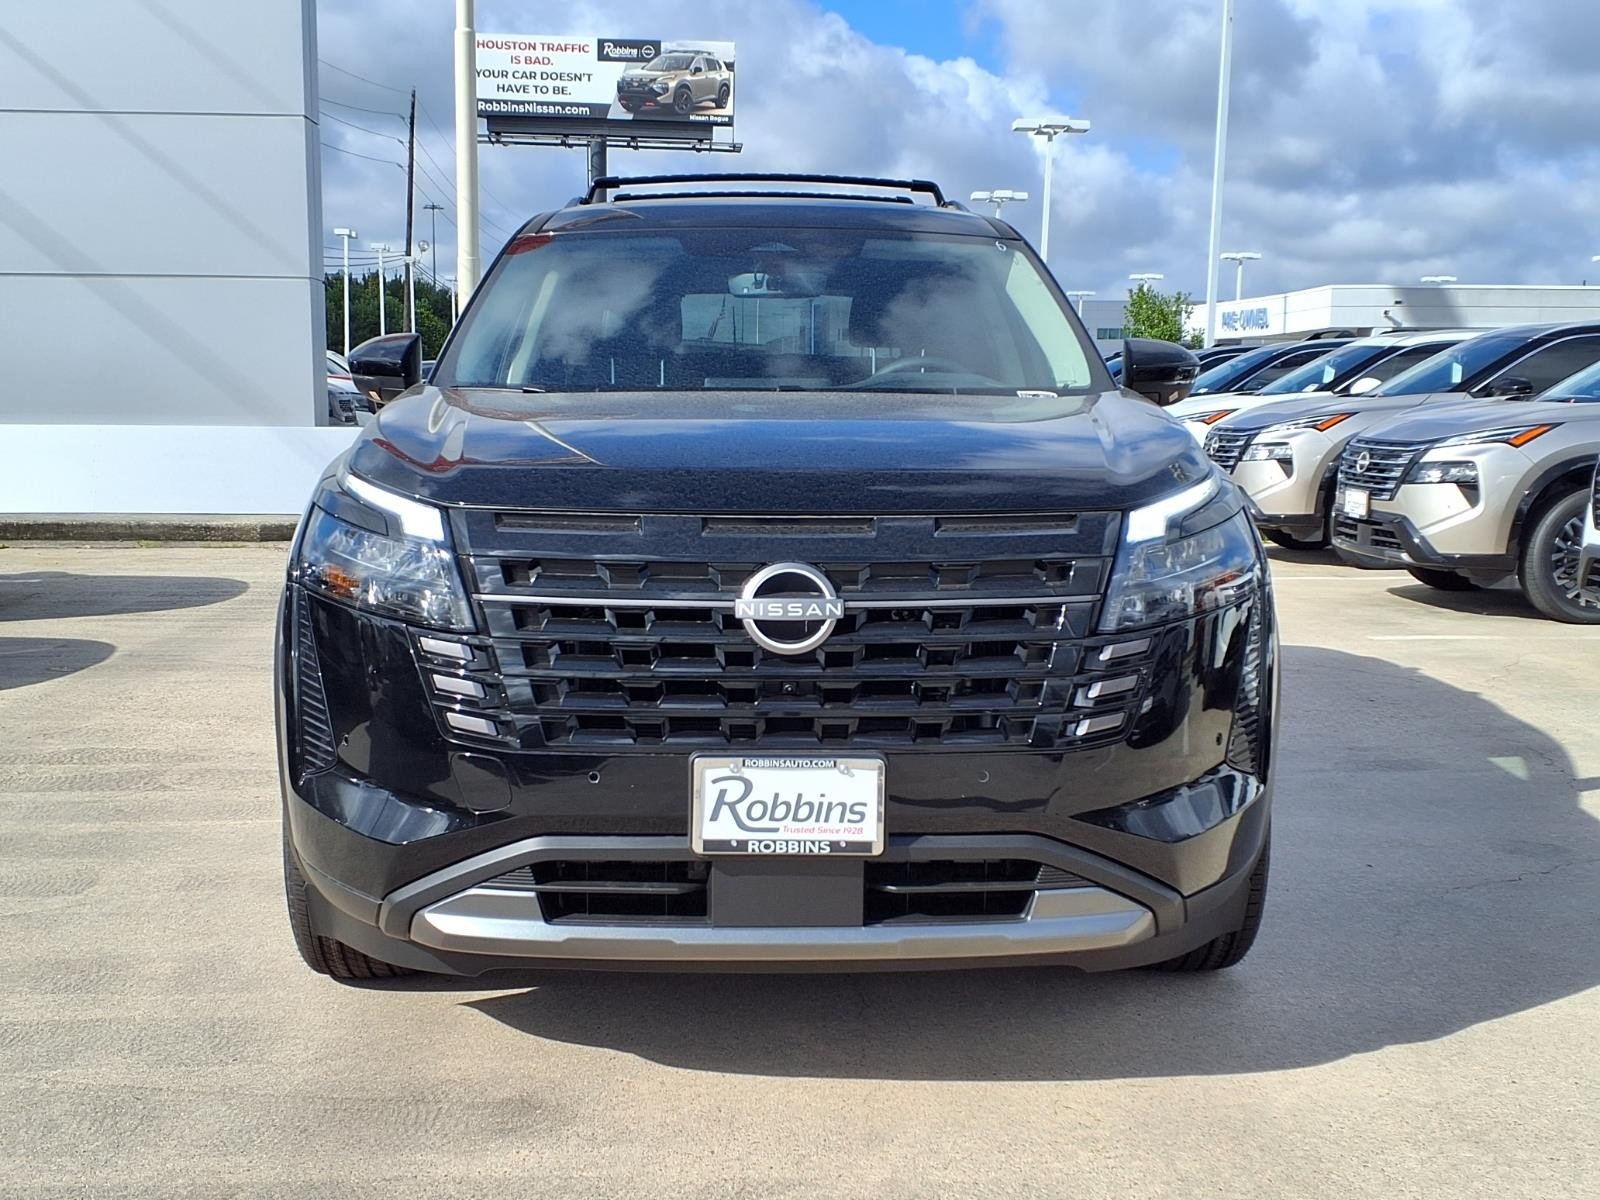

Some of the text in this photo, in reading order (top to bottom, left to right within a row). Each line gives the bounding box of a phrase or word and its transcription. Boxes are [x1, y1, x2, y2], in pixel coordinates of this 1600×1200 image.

[476, 39, 590, 54] HOUSTON TRAFFIC
[510, 55, 554, 66] IS BAD.
[475, 68, 593, 82] YOUR CAR DOESN'T
[496, 83, 572, 96] HAVE TO BE.
[477, 100, 590, 116] RobbinsNissan.com
[739, 602, 842, 617] NISSAN
[744, 758, 835, 769] ROBBINSAUTO.COM
[709, 775, 868, 833] Robbins
[783, 825, 864, 835] Trusted Since 1928
[747, 840, 831, 854] ROBBINS
